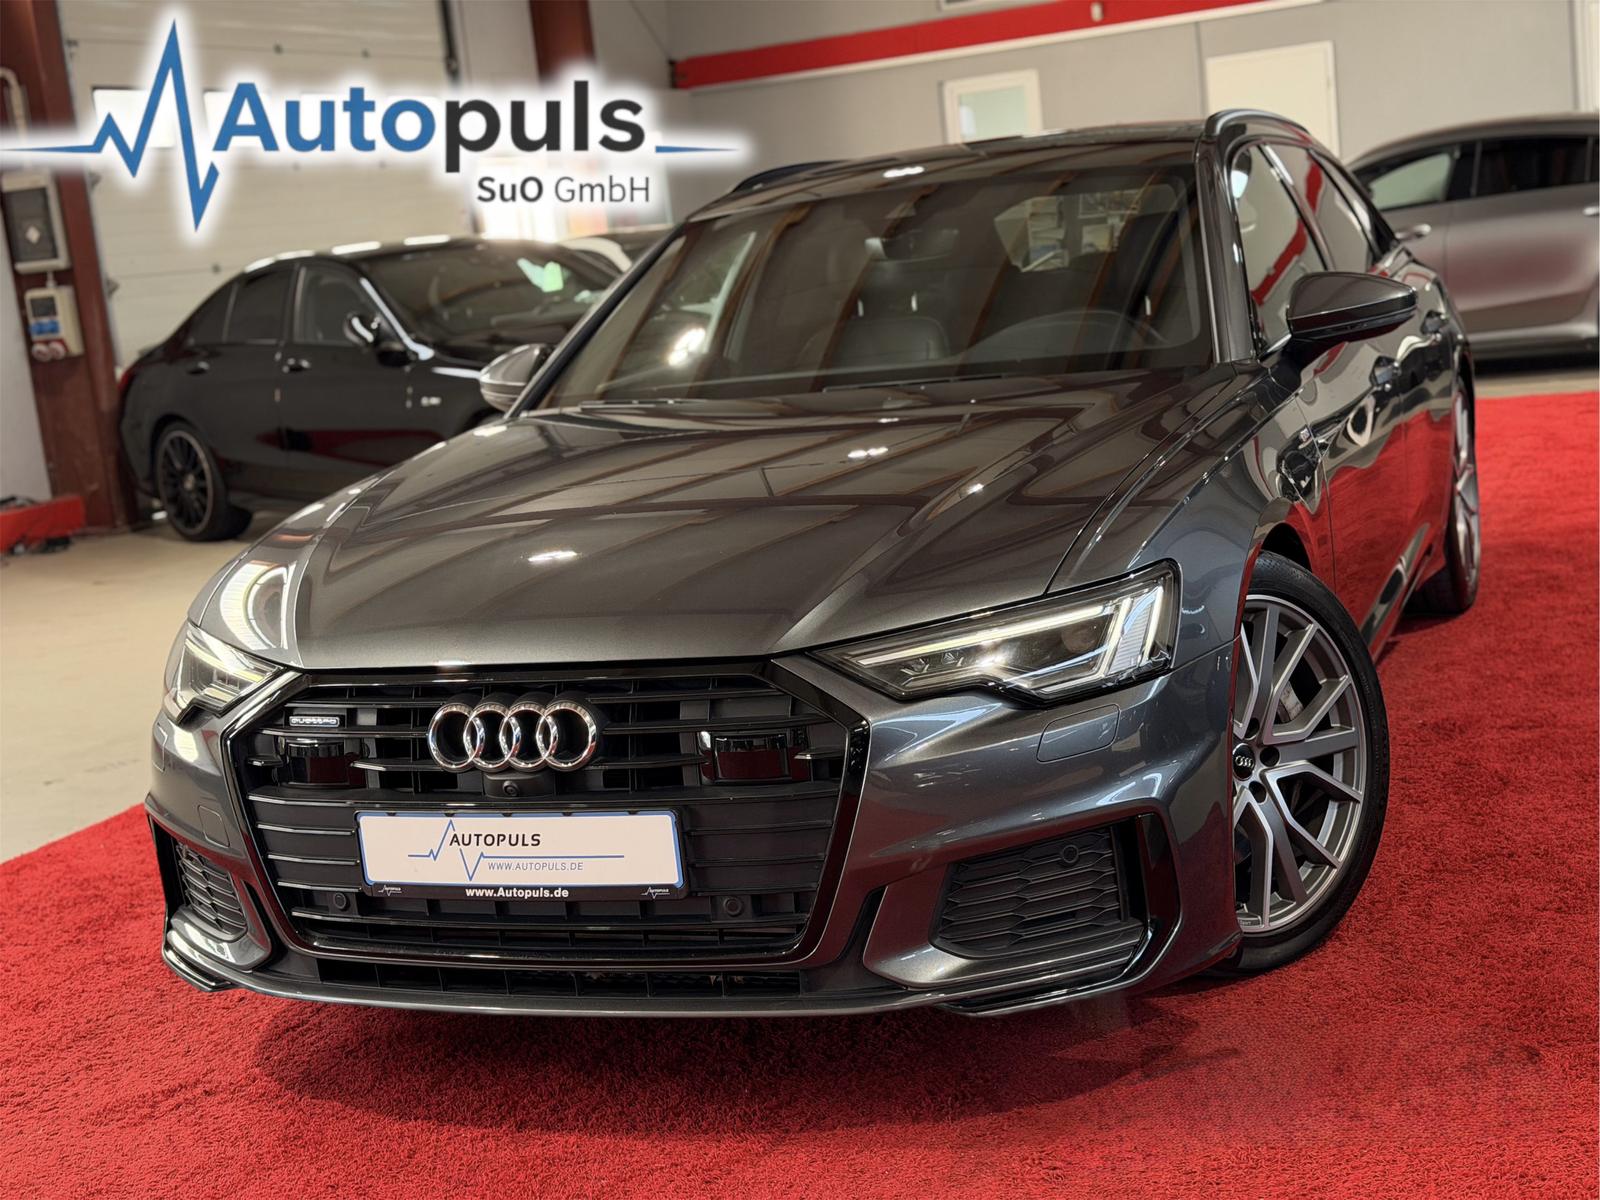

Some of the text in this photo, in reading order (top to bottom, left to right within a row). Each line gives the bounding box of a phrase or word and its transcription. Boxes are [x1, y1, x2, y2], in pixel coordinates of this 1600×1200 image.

[449, 833, 541, 847] AUTOPULS
[487, 862, 584, 871] WWW.AUTOPULS.DE
[465, 886, 570, 899] www.Autopuls.de
